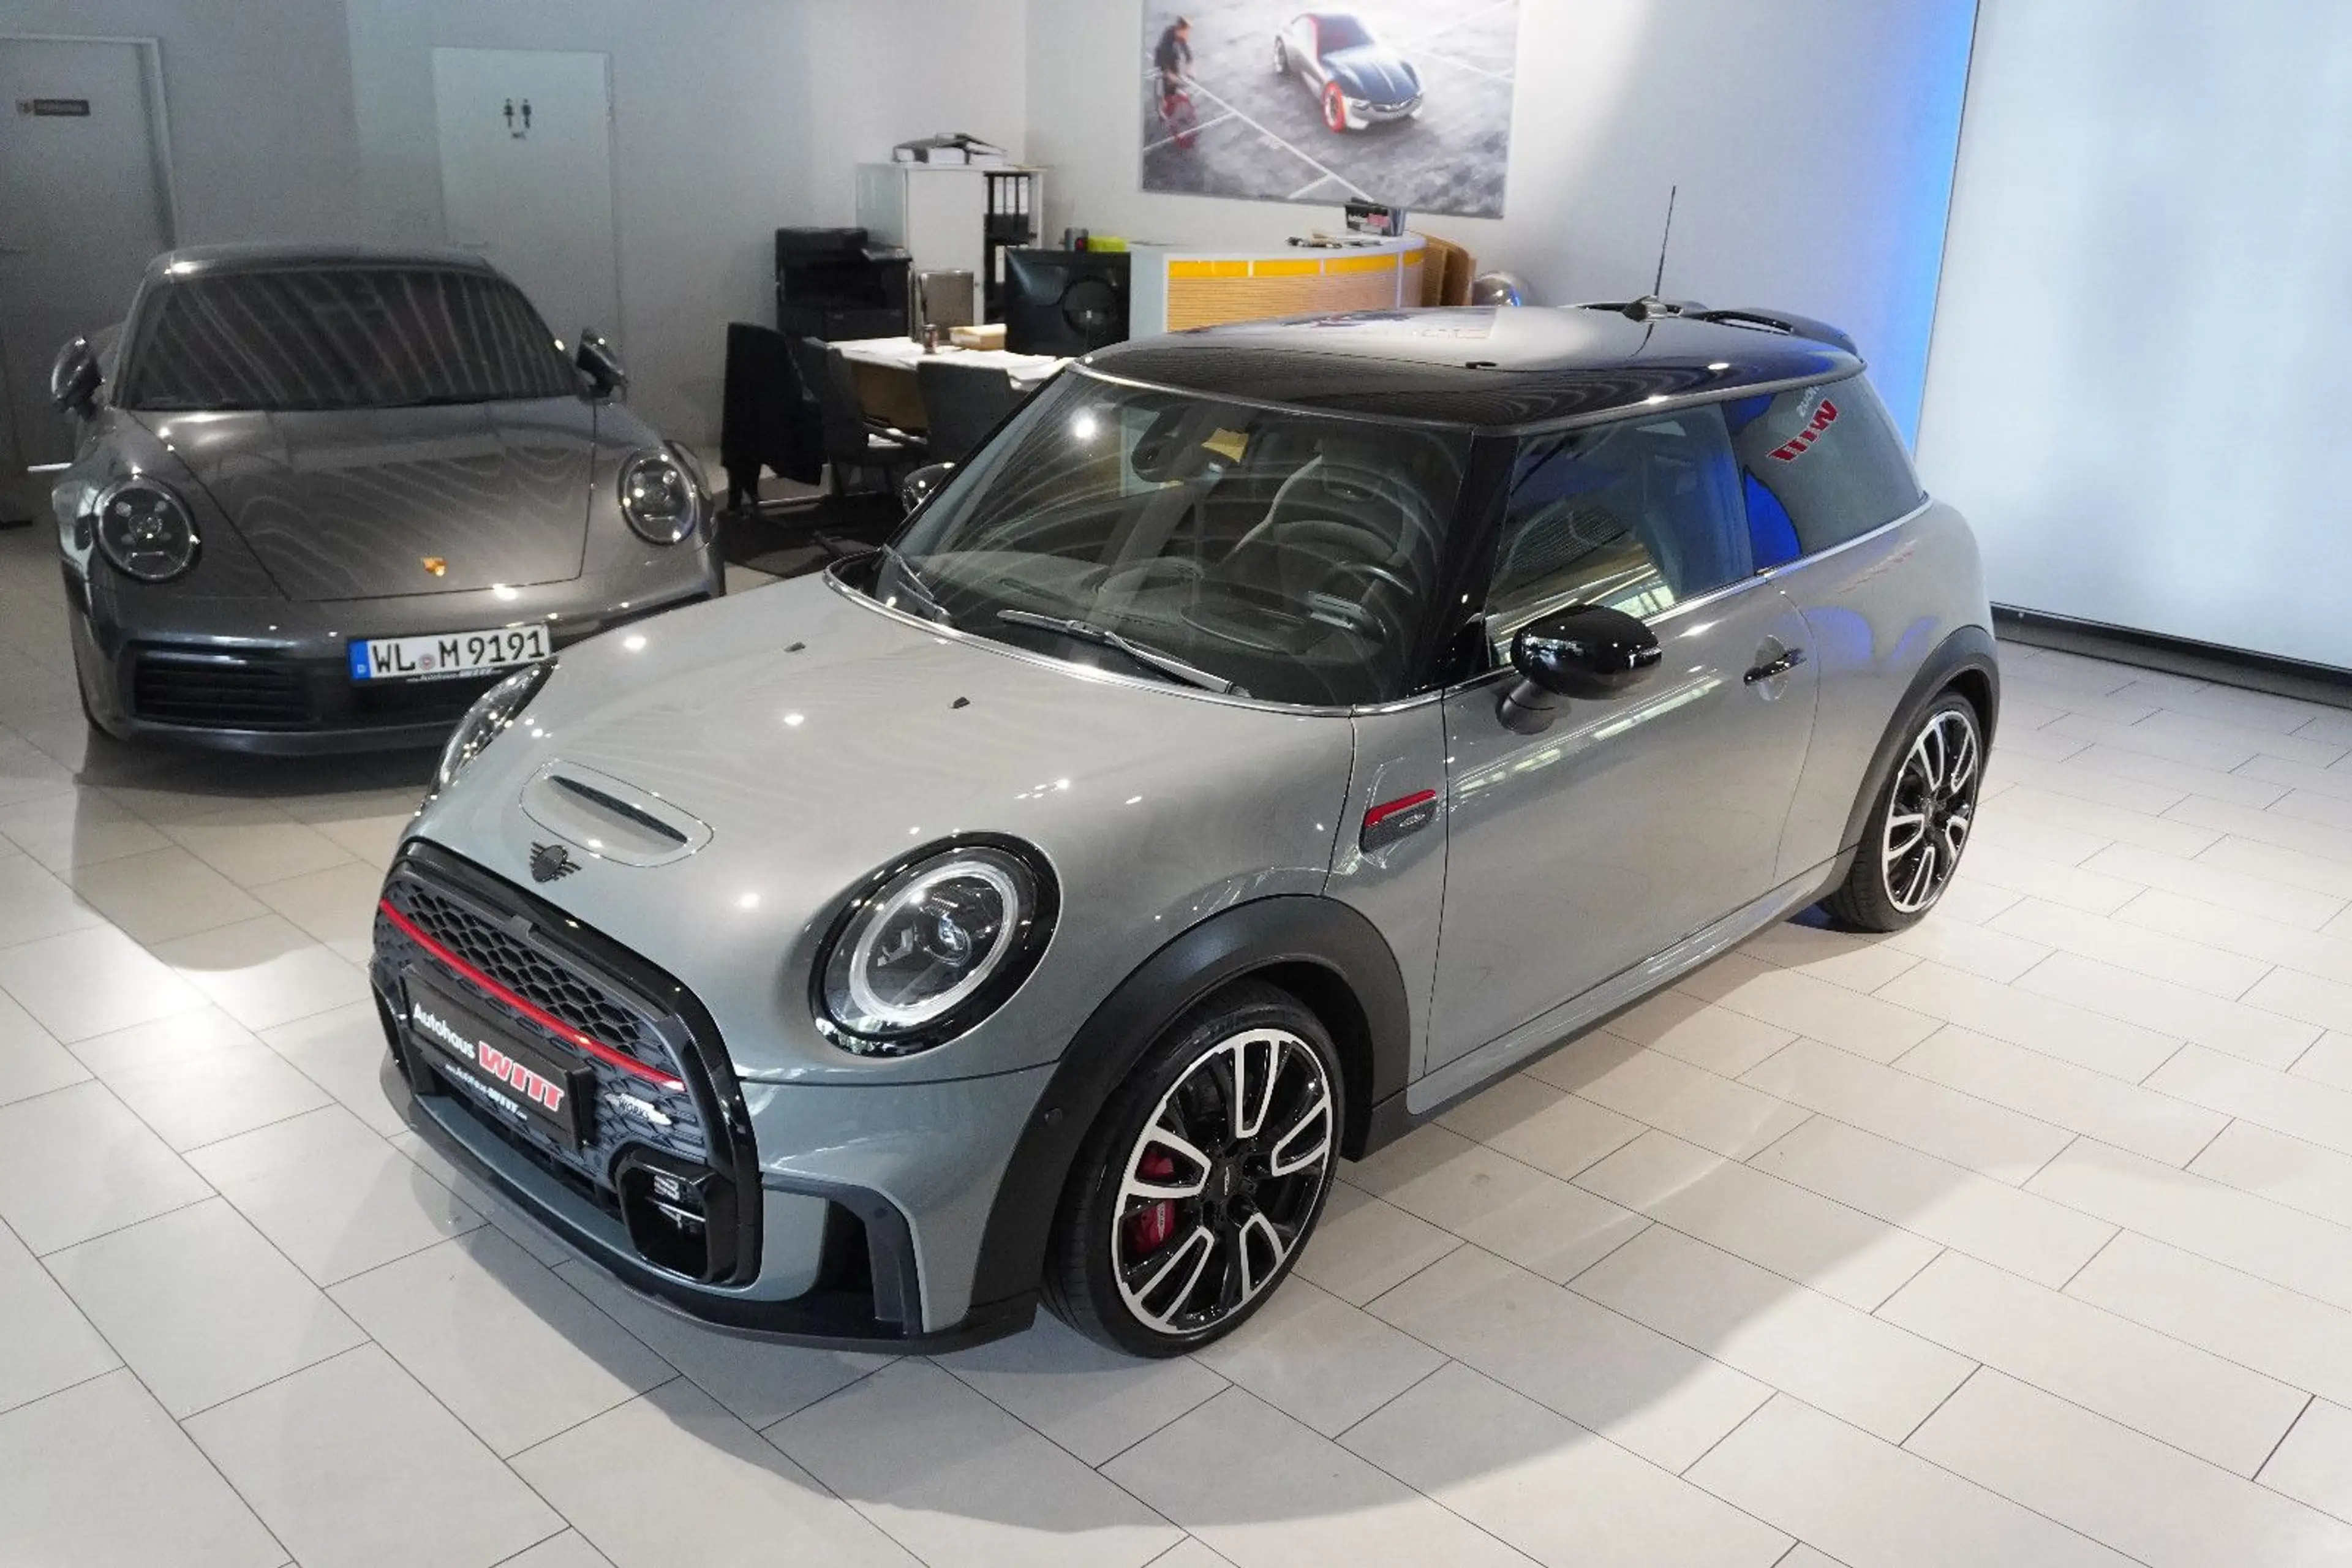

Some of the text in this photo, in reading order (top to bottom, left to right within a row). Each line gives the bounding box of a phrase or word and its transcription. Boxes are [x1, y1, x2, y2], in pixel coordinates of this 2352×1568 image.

[371, 630, 545, 673] WL M 9191
[413, 1002, 565, 1112] Autohaus WITT
